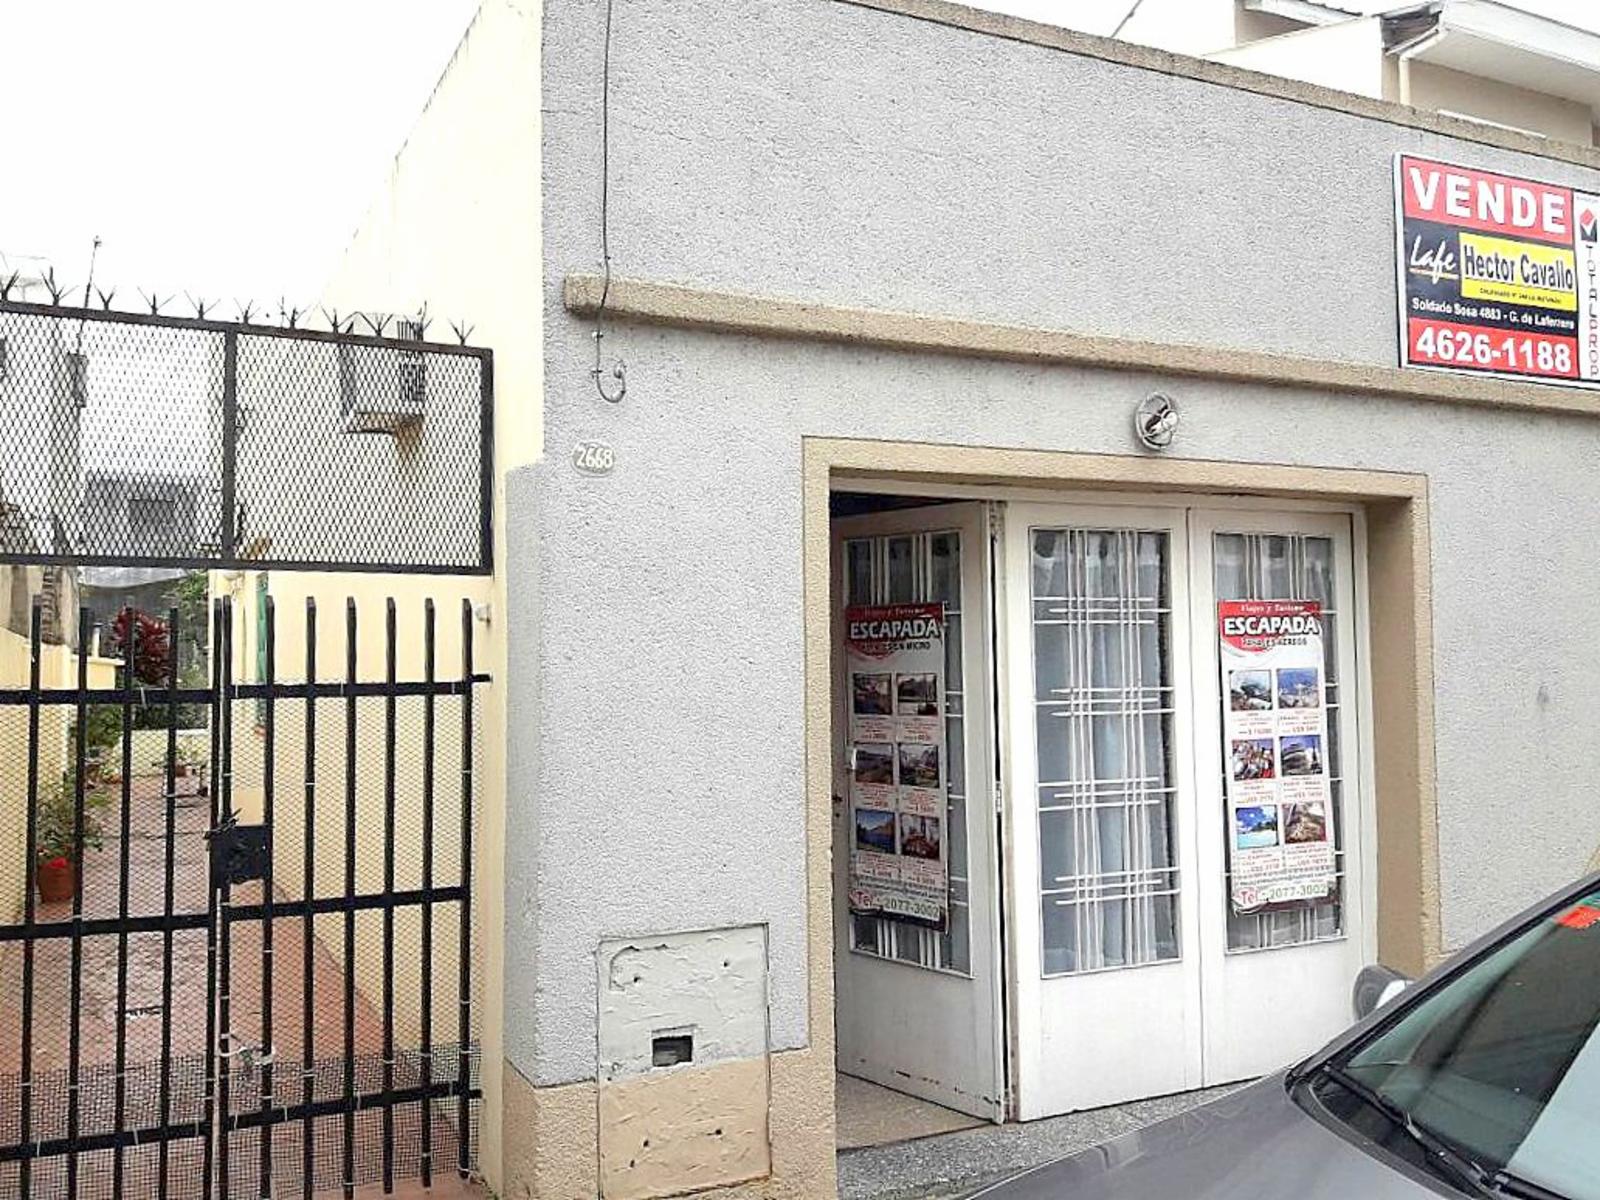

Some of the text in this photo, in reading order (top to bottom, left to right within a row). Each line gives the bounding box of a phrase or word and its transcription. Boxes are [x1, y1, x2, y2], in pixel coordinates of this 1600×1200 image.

[1409, 167, 1567, 234] VENDE
[1410, 235, 1457, 284] Lafe
[1464, 245, 1573, 290] Hector Cavallo
[1412, 297, 1453, 314] Soldado
[1416, 327, 1573, 373] 4626-1188
[850, 619, 939, 640] ESCAPADA
[1224, 615, 1319, 636] ESCAPADA
